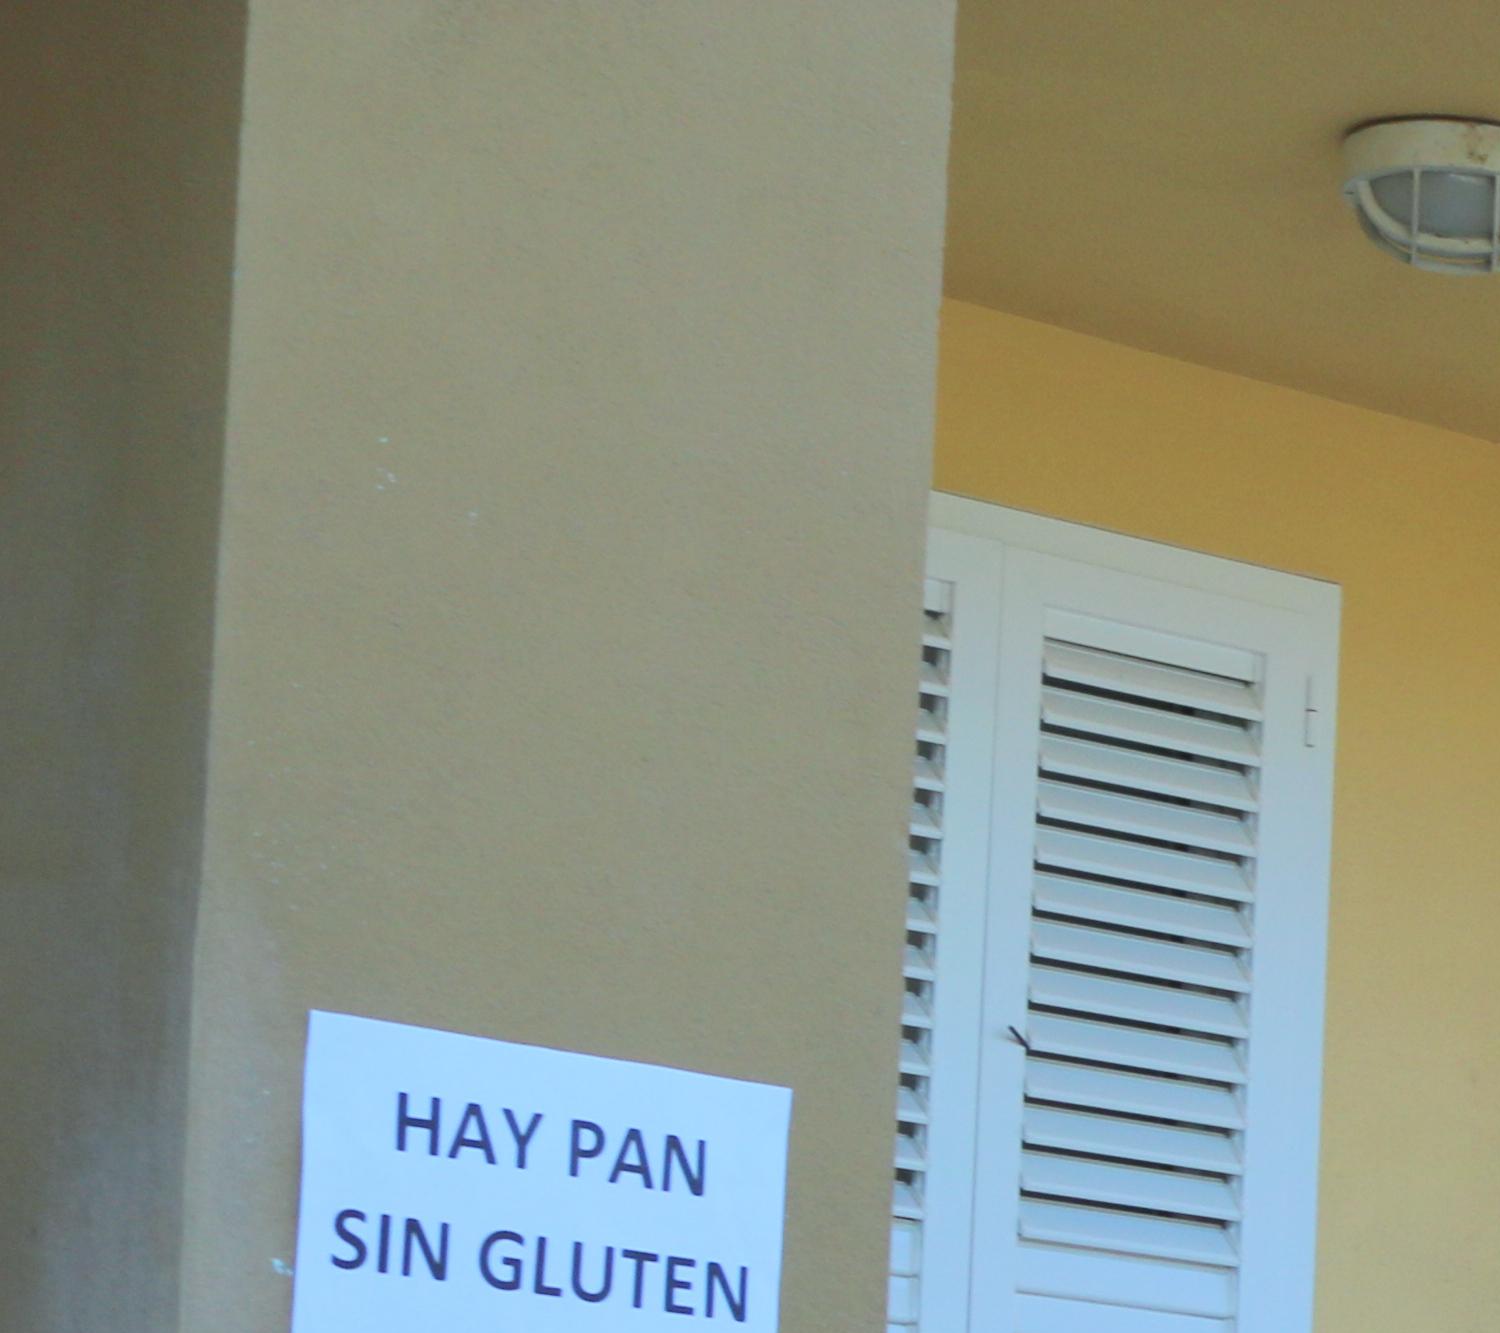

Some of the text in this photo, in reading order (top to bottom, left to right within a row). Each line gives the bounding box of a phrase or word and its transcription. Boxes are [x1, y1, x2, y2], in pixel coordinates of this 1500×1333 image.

[395, 1092, 706, 1197] HAY PAN
[331, 1209, 748, 1323] SIN GLUTEN
